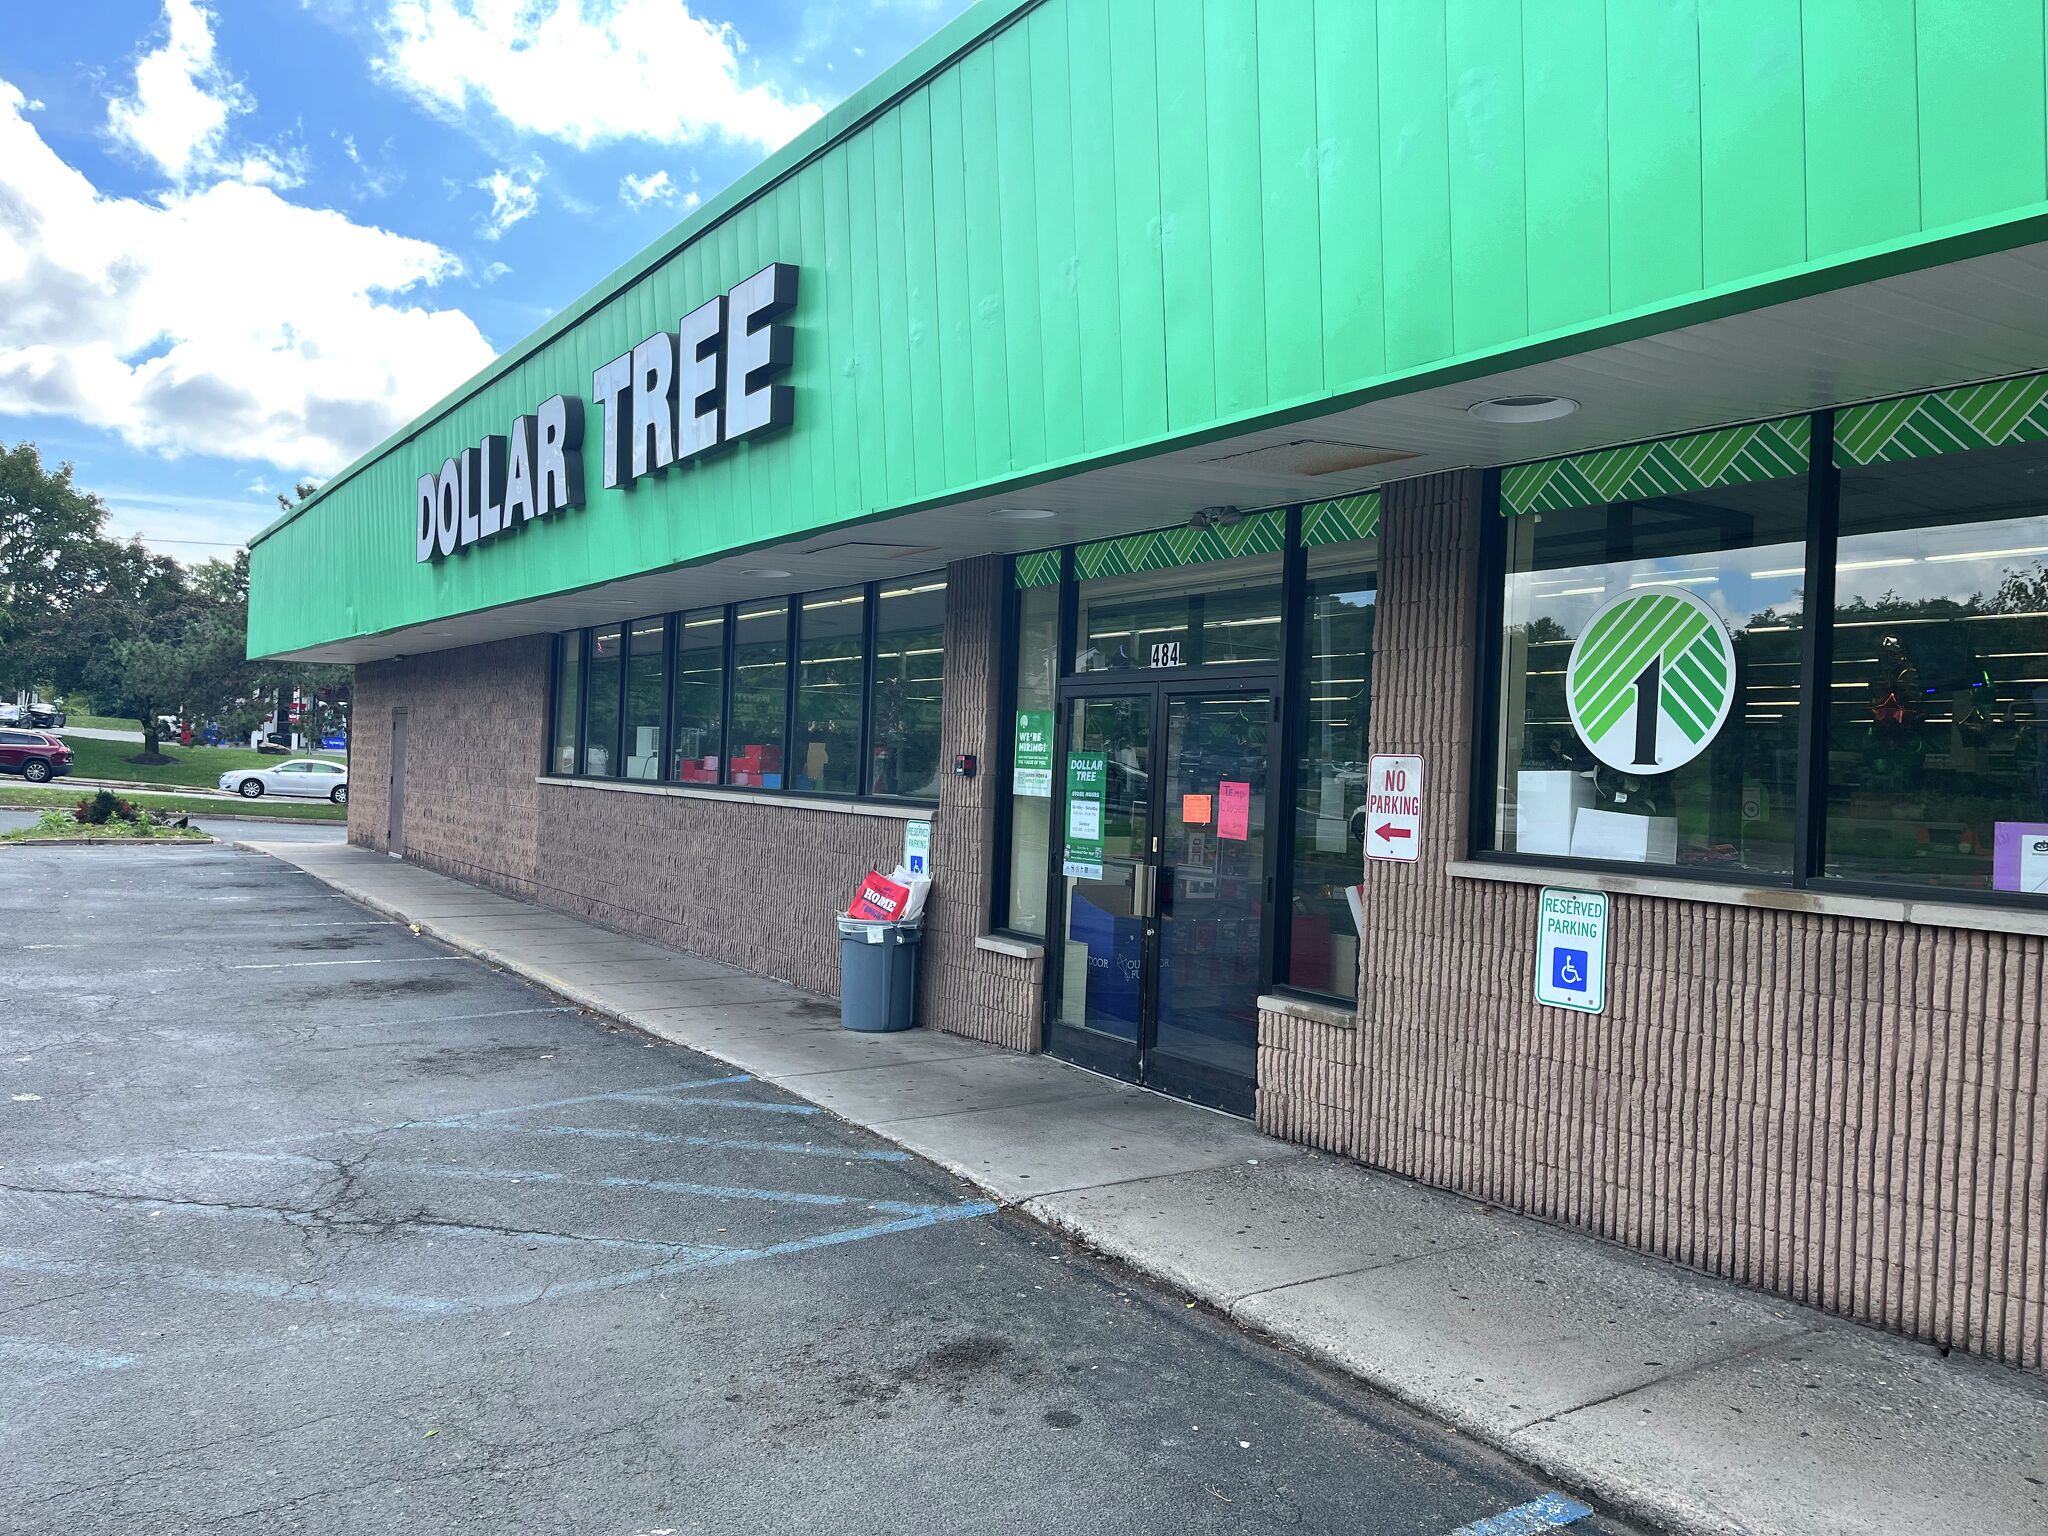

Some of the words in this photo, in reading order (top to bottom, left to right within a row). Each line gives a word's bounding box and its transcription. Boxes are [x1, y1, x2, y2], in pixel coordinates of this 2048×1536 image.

[416, 394, 581, 563] DOLLAR
[593, 262, 797, 489] TREE
[1152, 643, 1178, 666] 484
[1020, 732, 1042, 741] WE'RE
[1018, 742, 1047, 753] HIRING!
[1070, 760, 1104, 771] DOLLAR
[1076, 771, 1097, 782] TREE
[1385, 769, 1406, 792] NO
[1370, 795, 1419, 816] PARKING
[908, 827, 929, 838] RESERVED
[908, 840, 927, 850] PARKING
[863, 887, 897, 913] HOME
[1545, 898, 1602, 918] RESERVED
[1547, 918, 1597, 938] PARKING
